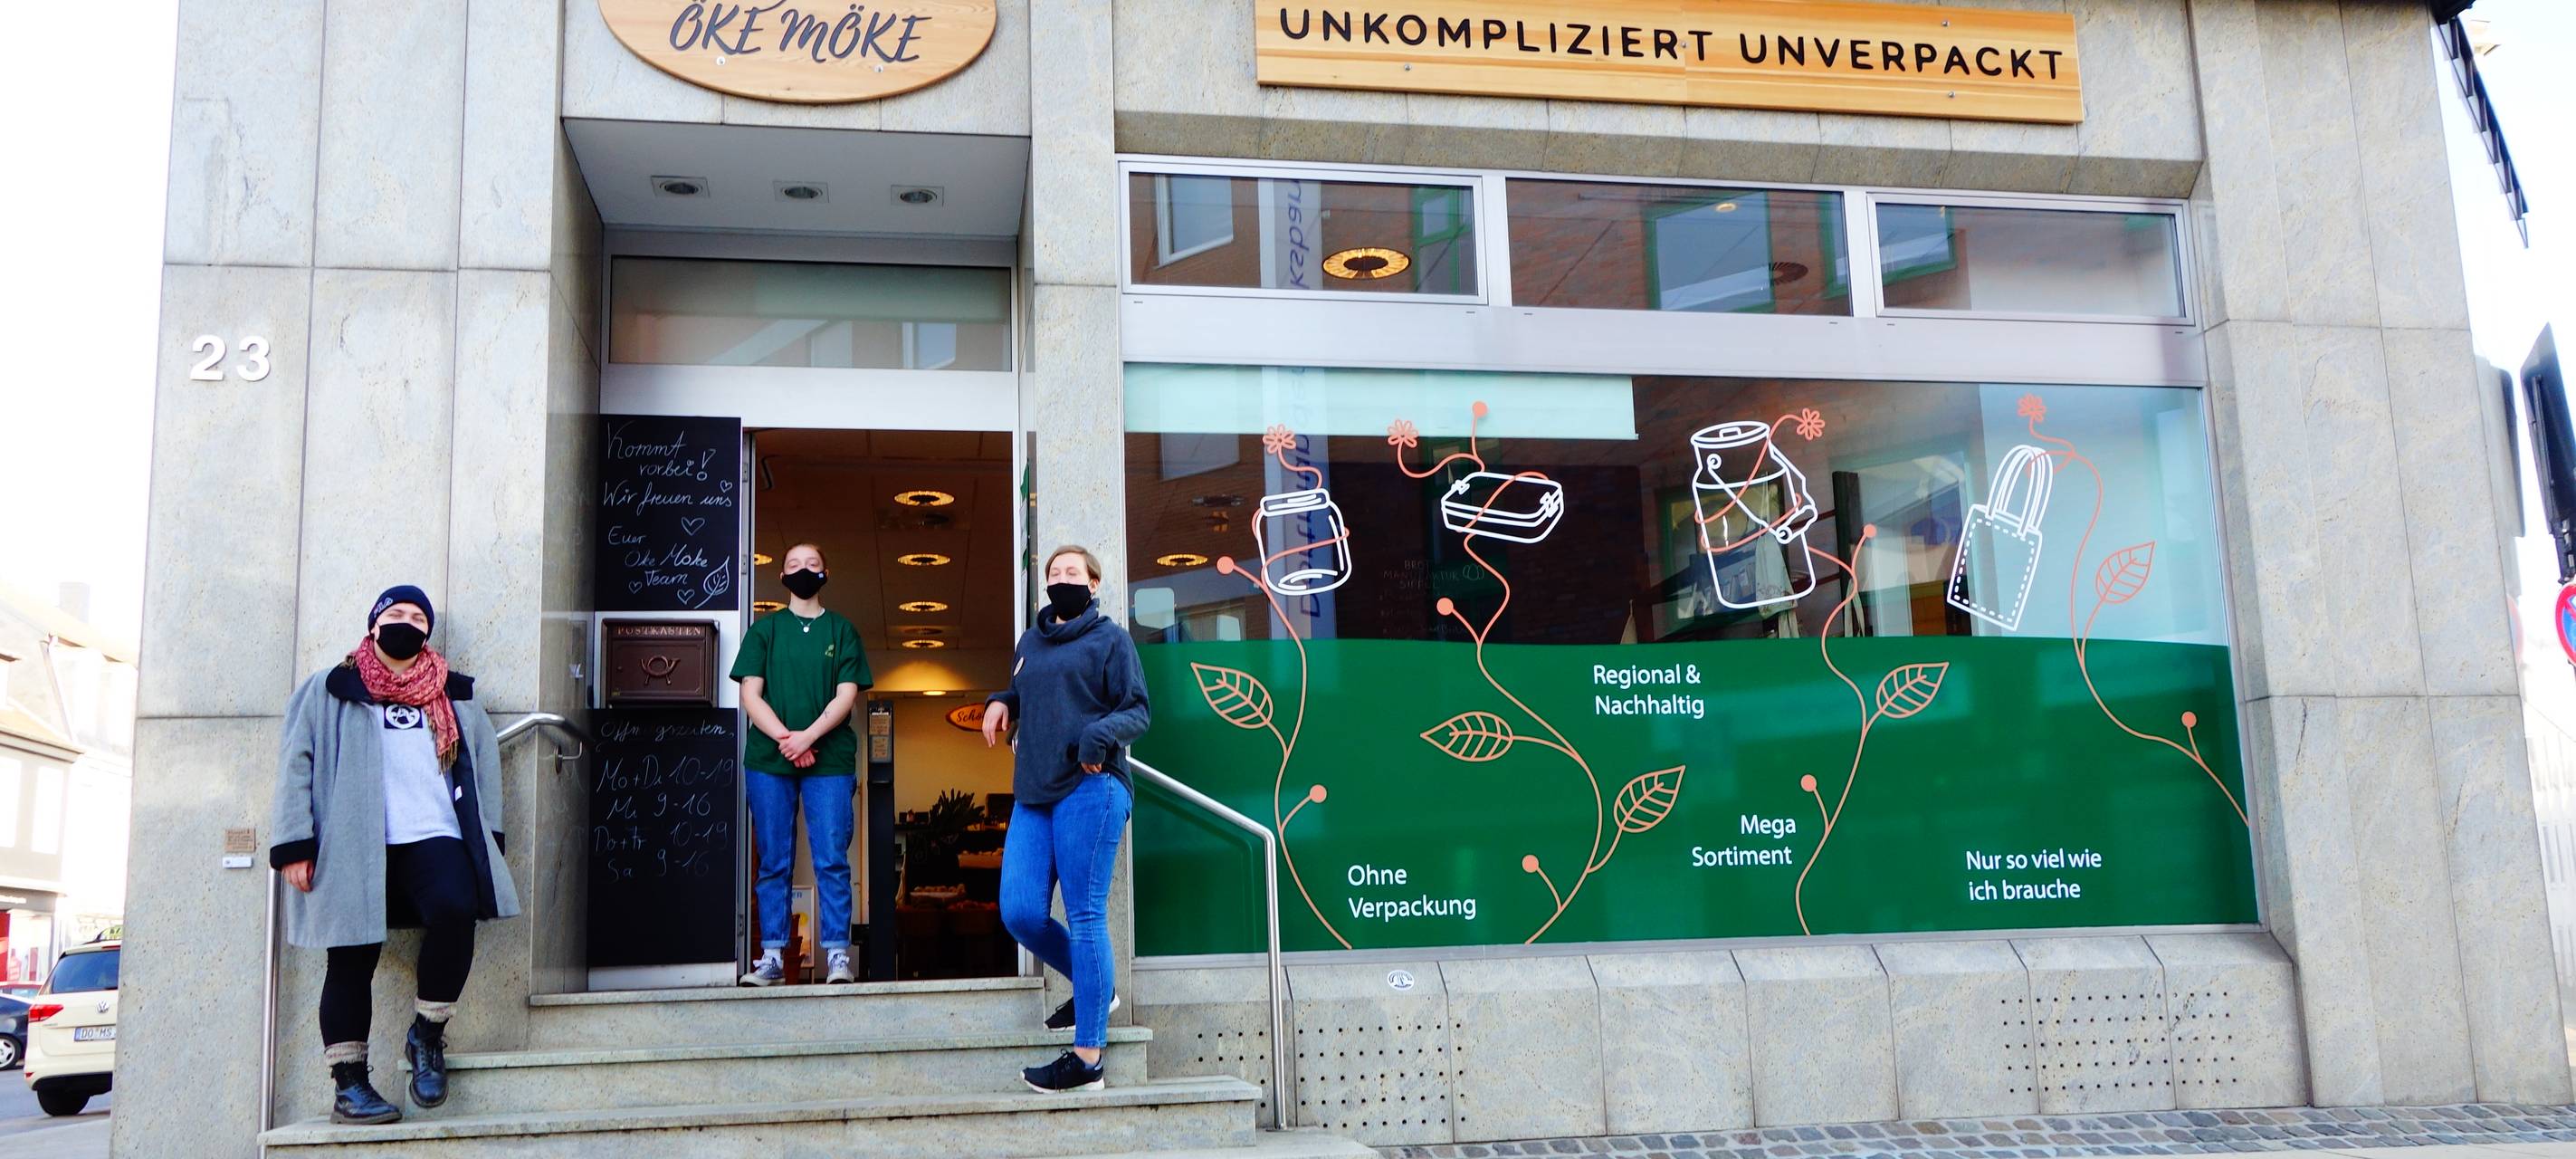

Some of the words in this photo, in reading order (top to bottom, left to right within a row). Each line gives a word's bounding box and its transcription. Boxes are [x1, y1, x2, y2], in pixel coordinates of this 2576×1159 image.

[779, 4, 932, 63] MÖKE
[1279, 7, 1713, 62] UNKOMPLIZIERT
[1739, 33, 2063, 80] UNVERPACKT
[189, 334, 272, 382] 23
[607, 420, 687, 459] Kommt
[603, 479, 638, 506] Wir
[636, 482, 693, 516] freuen
[700, 493, 732, 507] uns
[608, 525, 647, 545] Euer
[644, 569, 688, 587] Team
[617, 625, 701, 636] POSTKASTEN
[1593, 663, 1681, 689] Regional
[1685, 664, 1702, 685] &
[1595, 694, 1705, 719] Nachhaltig
[606, 796, 637, 820] Mi
[1741, 814, 1797, 839] Mega
[1692, 846, 1793, 867] Sortiment
[1966, 849, 2001, 870] Nur
[2006, 853, 2028, 869] so
[2031, 848, 2065, 868] viel
[2067, 848, 2103, 868] wie
[607, 858, 633, 884] Sa
[1348, 863, 1407, 886] Ohne
[1969, 879, 1998, 901] ich
[2002, 877, 2081, 900] brauche
[1348, 894, 1477, 923] Verpackung
